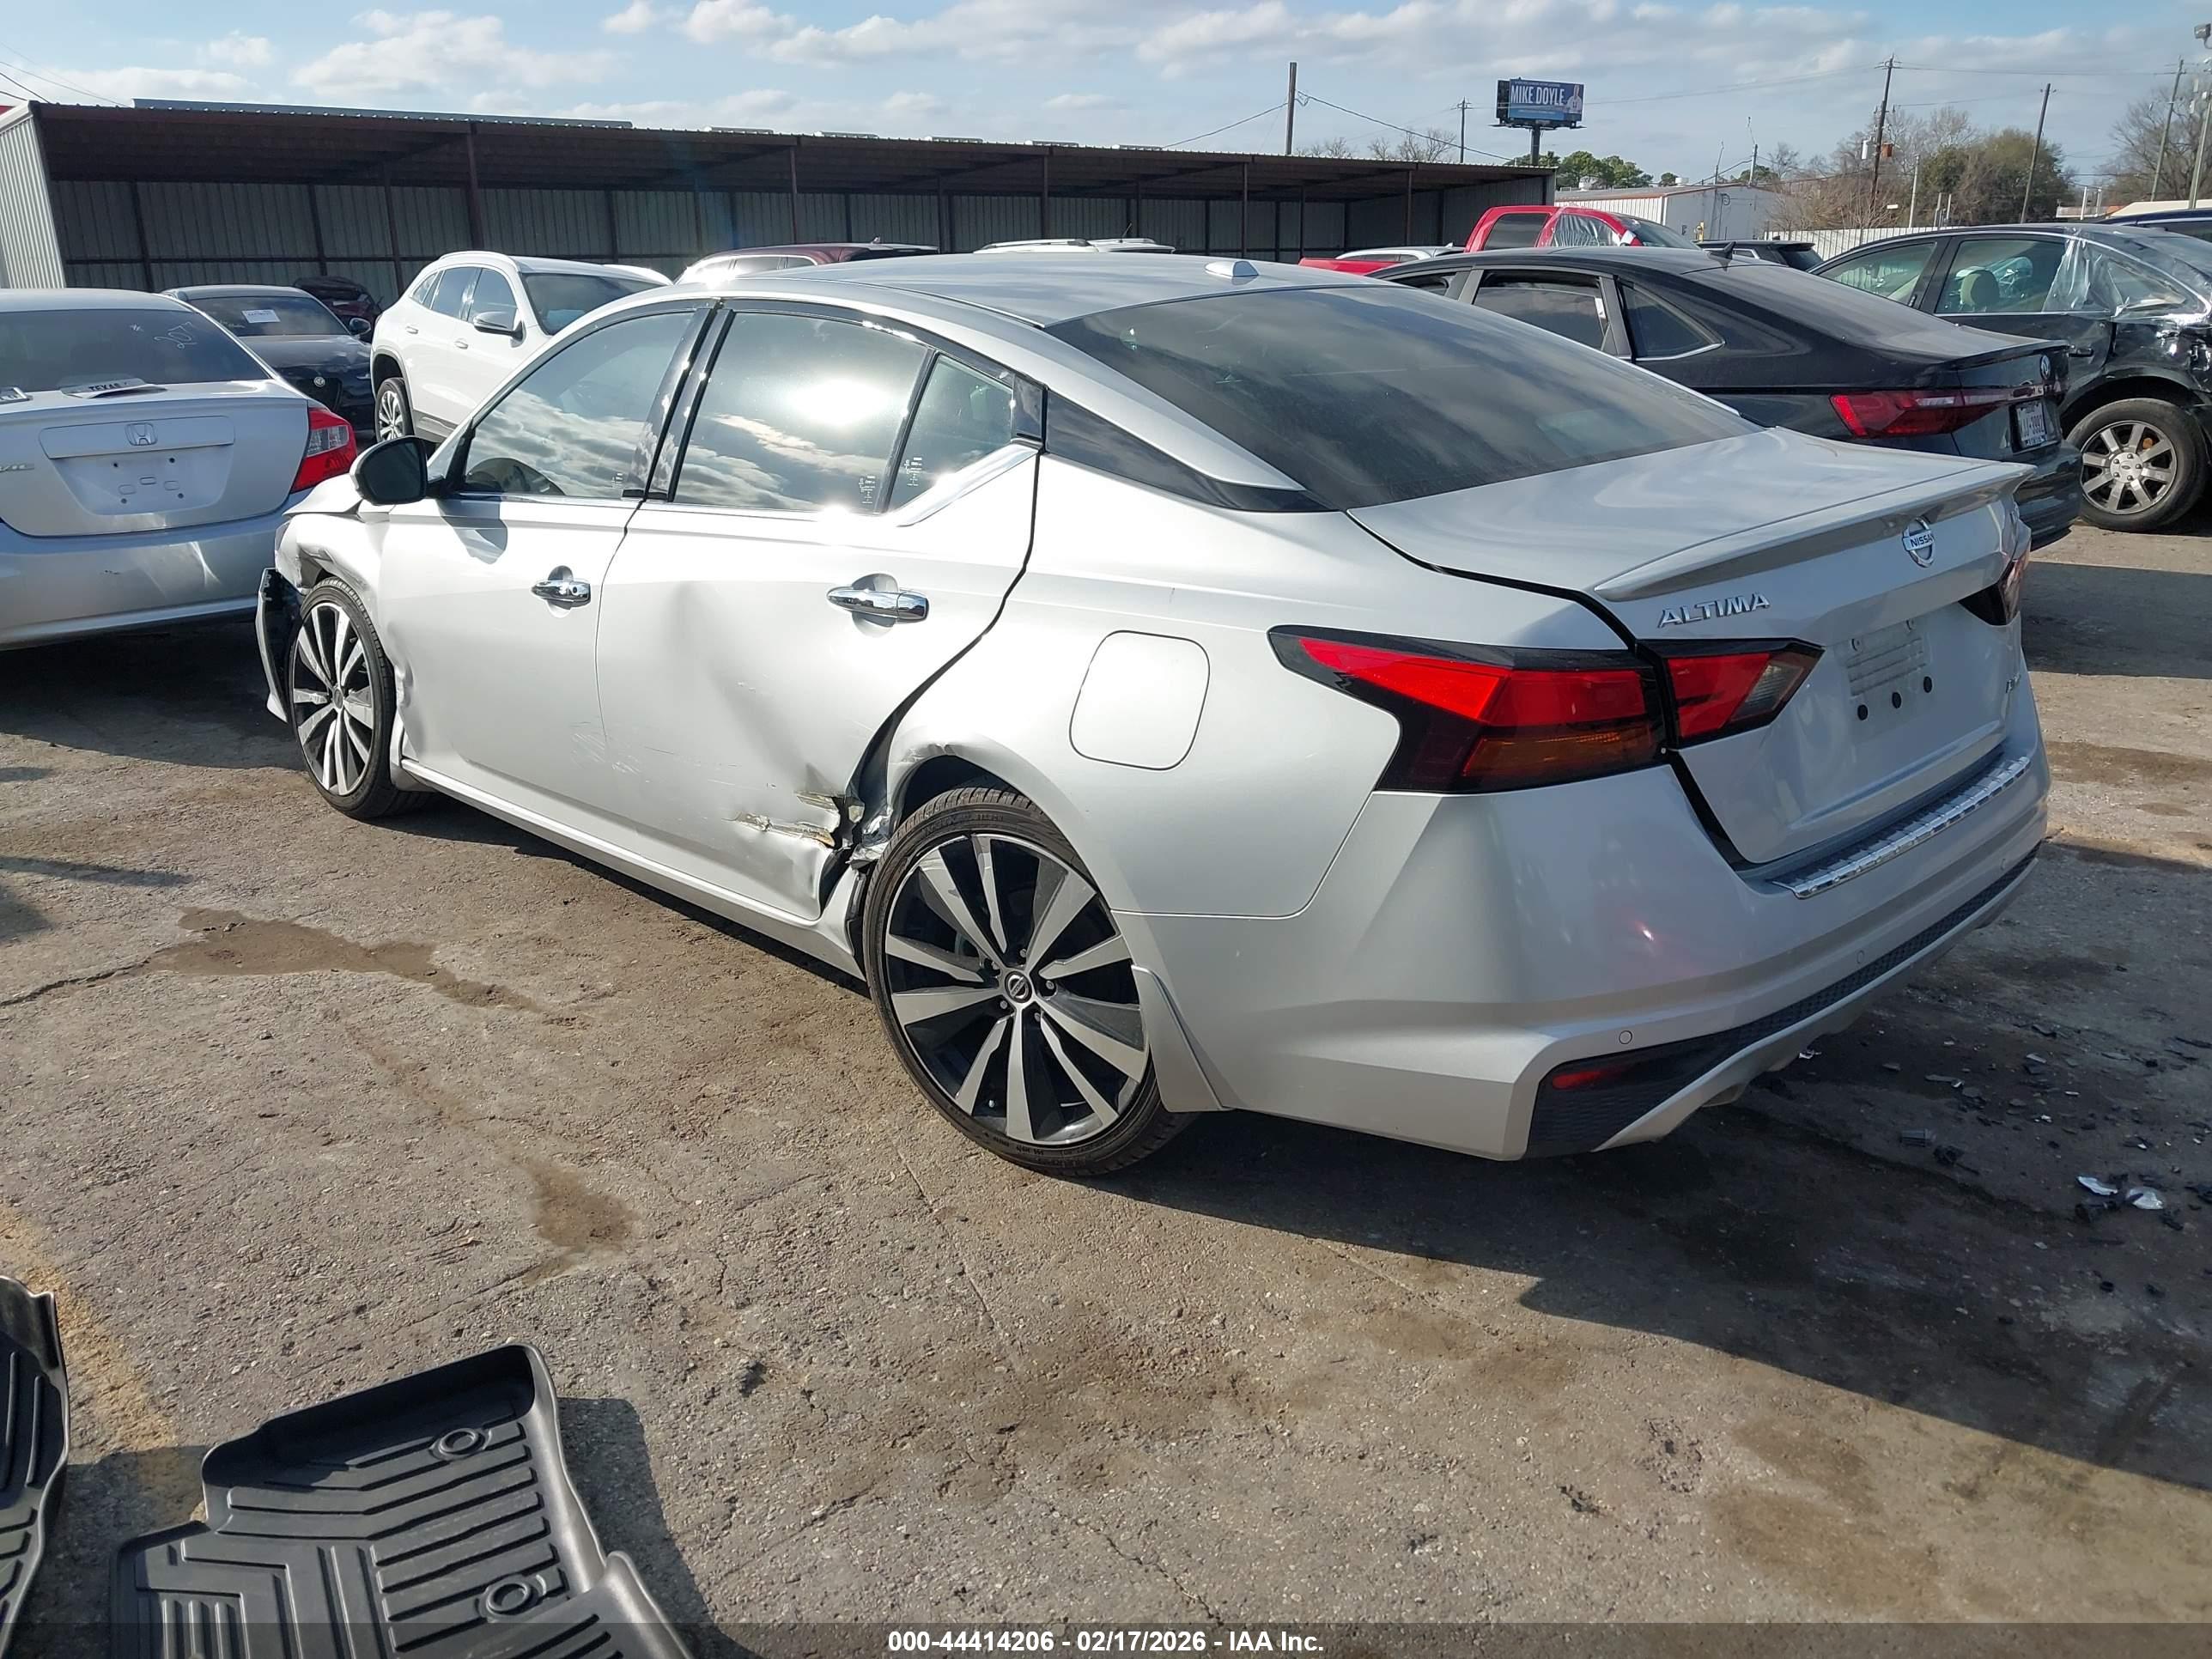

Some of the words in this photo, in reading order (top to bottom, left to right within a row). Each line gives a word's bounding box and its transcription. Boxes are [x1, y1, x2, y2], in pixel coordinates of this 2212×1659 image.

[1510, 85, 1534, 104] MIKE
[1536, 87, 1565, 106] DOYLE
[1910, 532, 1935, 548] NISSA
[1657, 592, 1771, 628] ALTIMA
